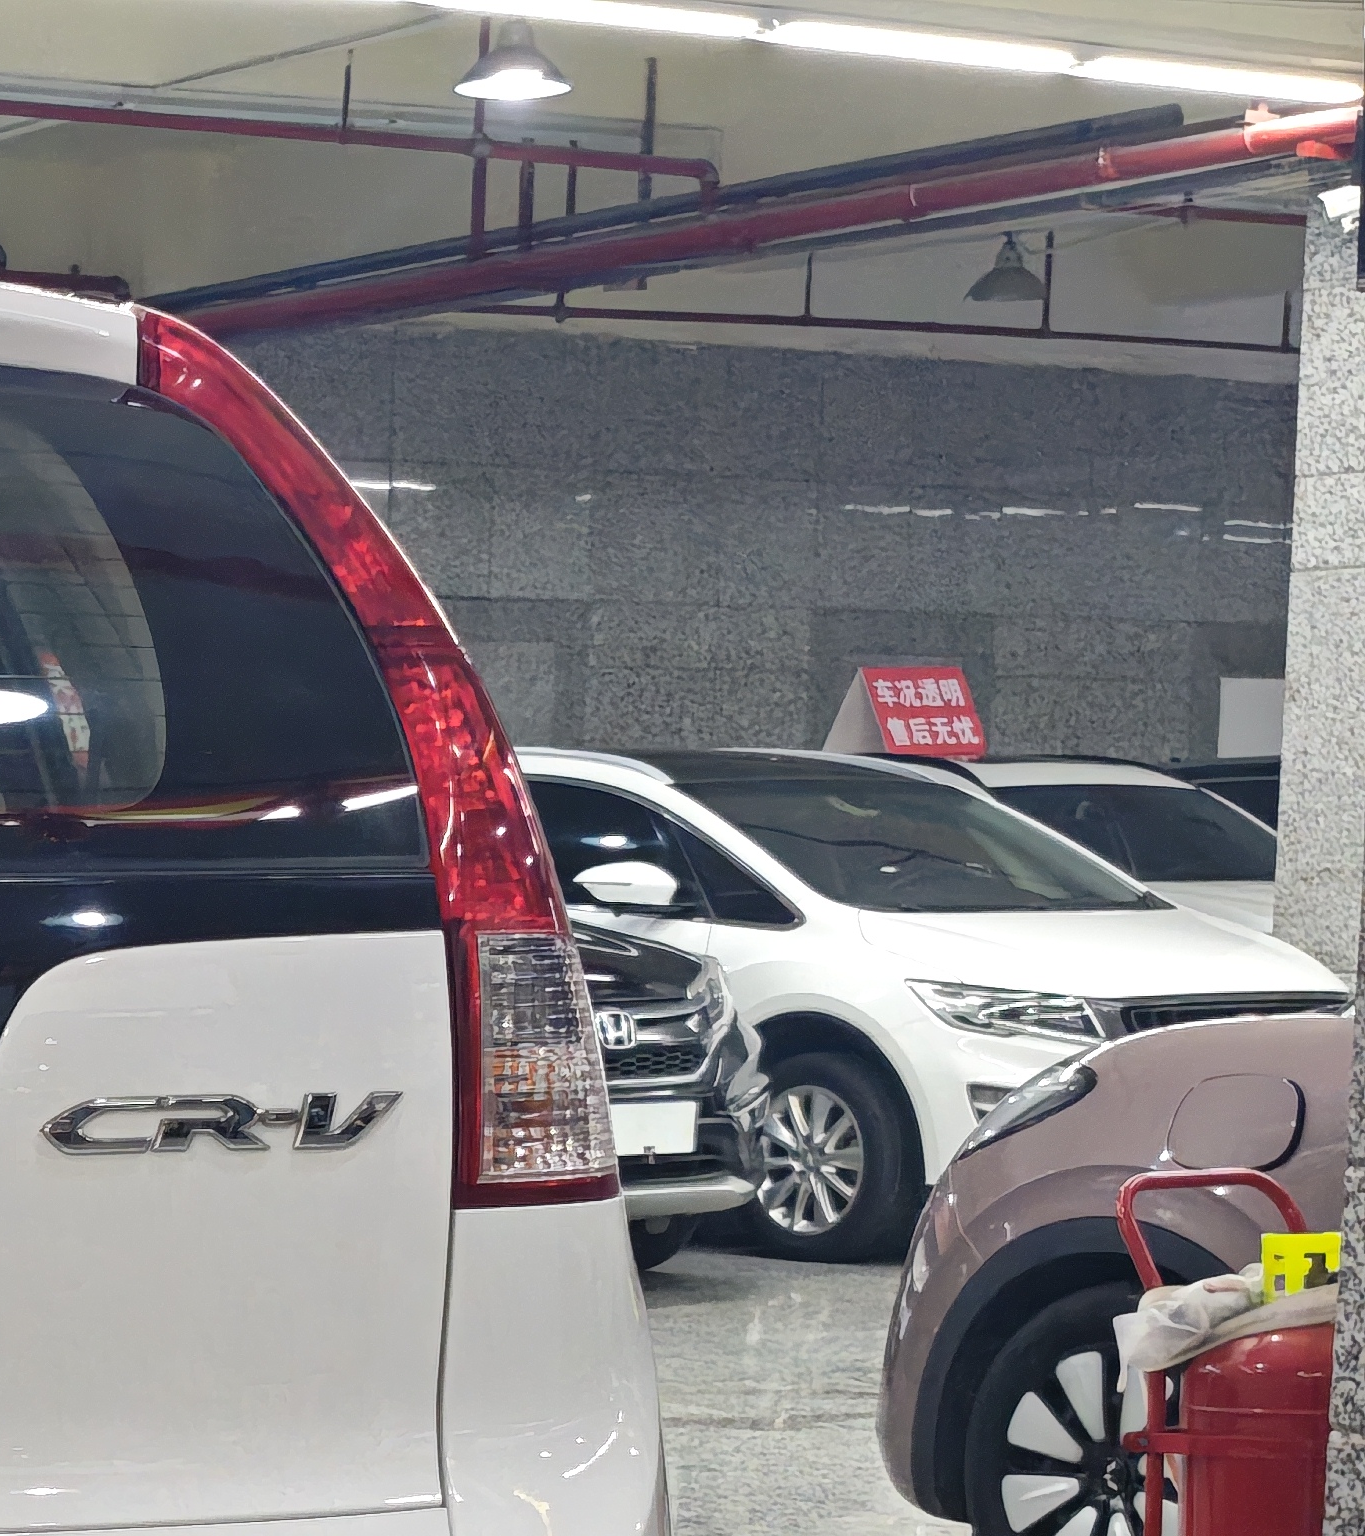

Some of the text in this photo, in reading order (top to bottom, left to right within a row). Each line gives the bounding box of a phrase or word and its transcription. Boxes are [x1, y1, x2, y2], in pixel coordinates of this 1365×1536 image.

[872, 677, 966, 708] 车况透明
[886, 714, 980, 747] 售后无忧
[38, 1090, 404, 1155] CR-V
